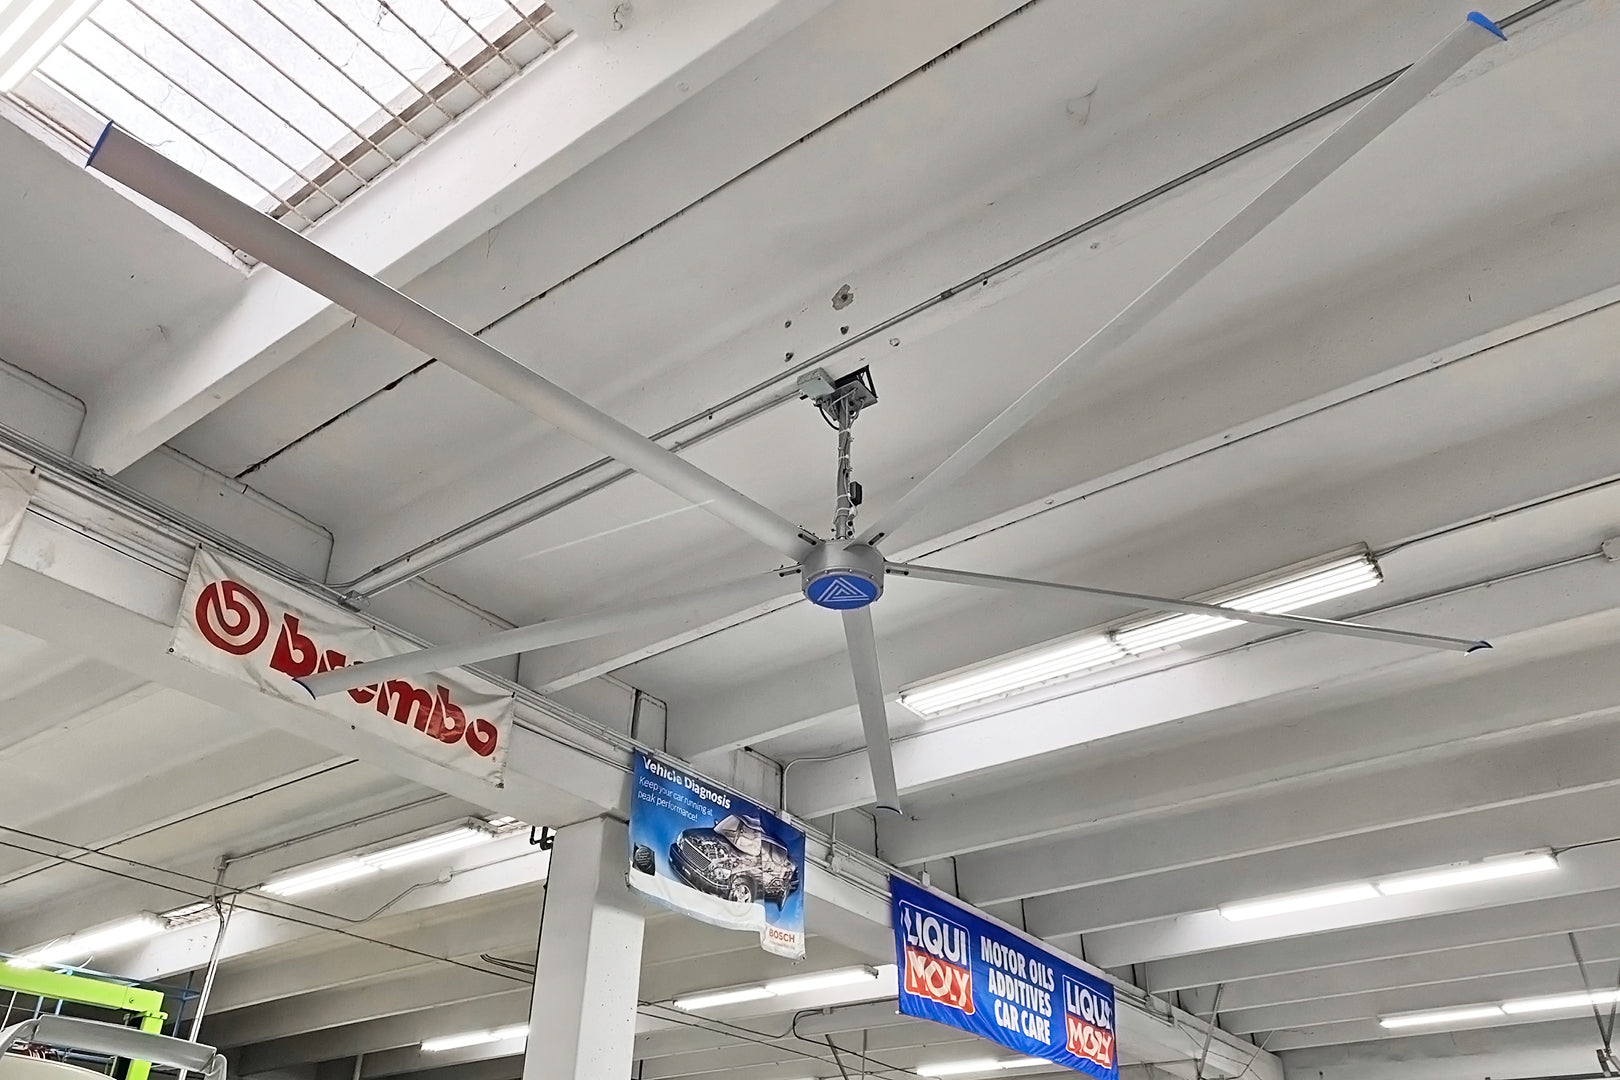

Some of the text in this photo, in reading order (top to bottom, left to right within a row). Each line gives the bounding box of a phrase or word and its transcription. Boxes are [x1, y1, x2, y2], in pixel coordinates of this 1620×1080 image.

[637, 790, 698, 822] peak performance!
[639, 776, 659, 790] Keep
[659, 785, 673, 798] your
[672, 792, 685, 803] car
[684, 797, 707, 816] running
[642, 755, 732, 809] Vehicle Diagnosis
[769, 929, 795, 943] BOSCH
[903, 907, 967, 966] LIQUI
[908, 951, 970, 1007] MOLY
[981, 936, 1055, 992] MOTOR OILS
[988, 967, 1052, 1018] ADDITIVES
[994, 999, 1050, 1046] CAR CARE
[1068, 1017, 1112, 1064] MOLY
